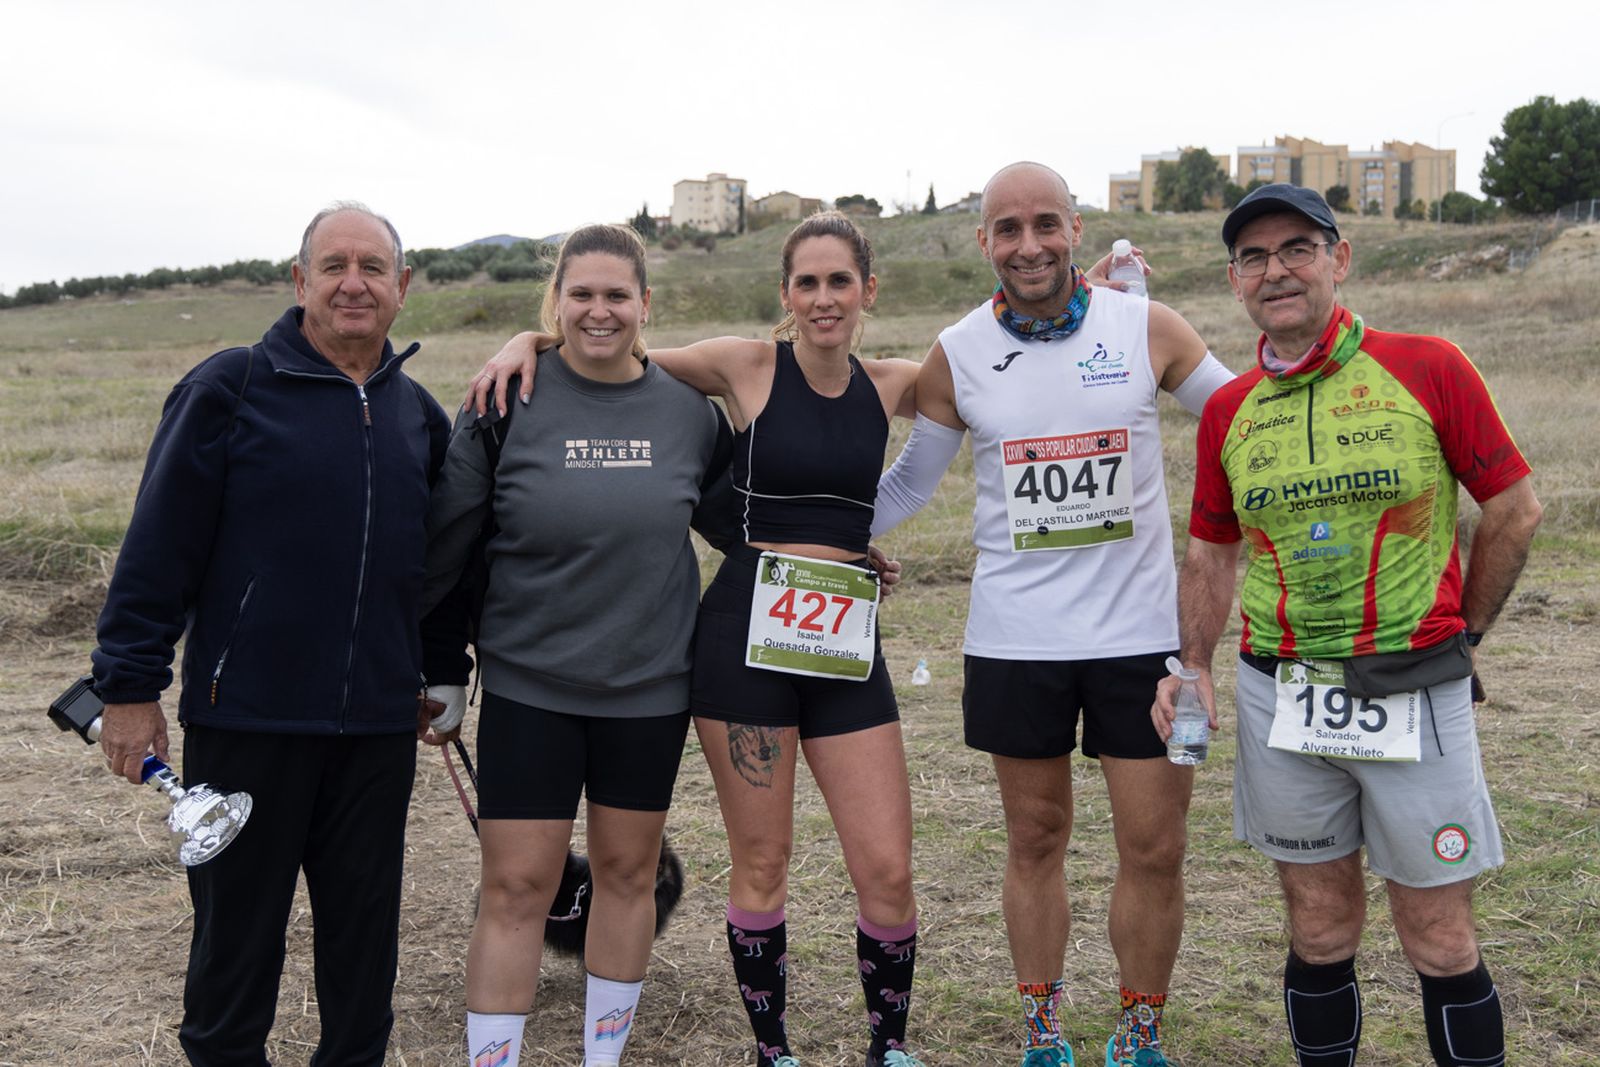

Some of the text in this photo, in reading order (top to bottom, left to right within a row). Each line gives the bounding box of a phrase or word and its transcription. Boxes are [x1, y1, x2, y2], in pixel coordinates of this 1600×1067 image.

[590, 439, 628, 447] TEAM CORE
[1352, 428, 1394, 444] DUE
[565, 448, 652, 459] ATHLETE
[1045, 438, 1076, 457] POPULAR
[1076, 435, 1099, 454] CIUDAD
[565, 460, 601, 469] MINDSET
[1014, 456, 1122, 504] 4047
[1282, 468, 1400, 500] HYUNDAI
[1056, 503, 1091, 512] EDUARDO
[1288, 489, 1400, 513] Jacarsa Motor
[1015, 506, 1130, 527] DEL CASTILLO MARTINEZ
[794, 576, 820, 586] Campo
[827, 581, 848, 590] través
[769, 588, 854, 635] 427
[864, 604, 874, 638] Veterana
[797, 630, 824, 641] Isabel
[763, 637, 860, 660] Quesada Gonzalez
[1296, 685, 1388, 733] 195
[1406, 696, 1416, 735] Veterano
[1315, 729, 1362, 742] Salvador
[1301, 742, 1384, 759] Alvarez Nieto
[1265, 833, 1300, 850] SALVADOR
